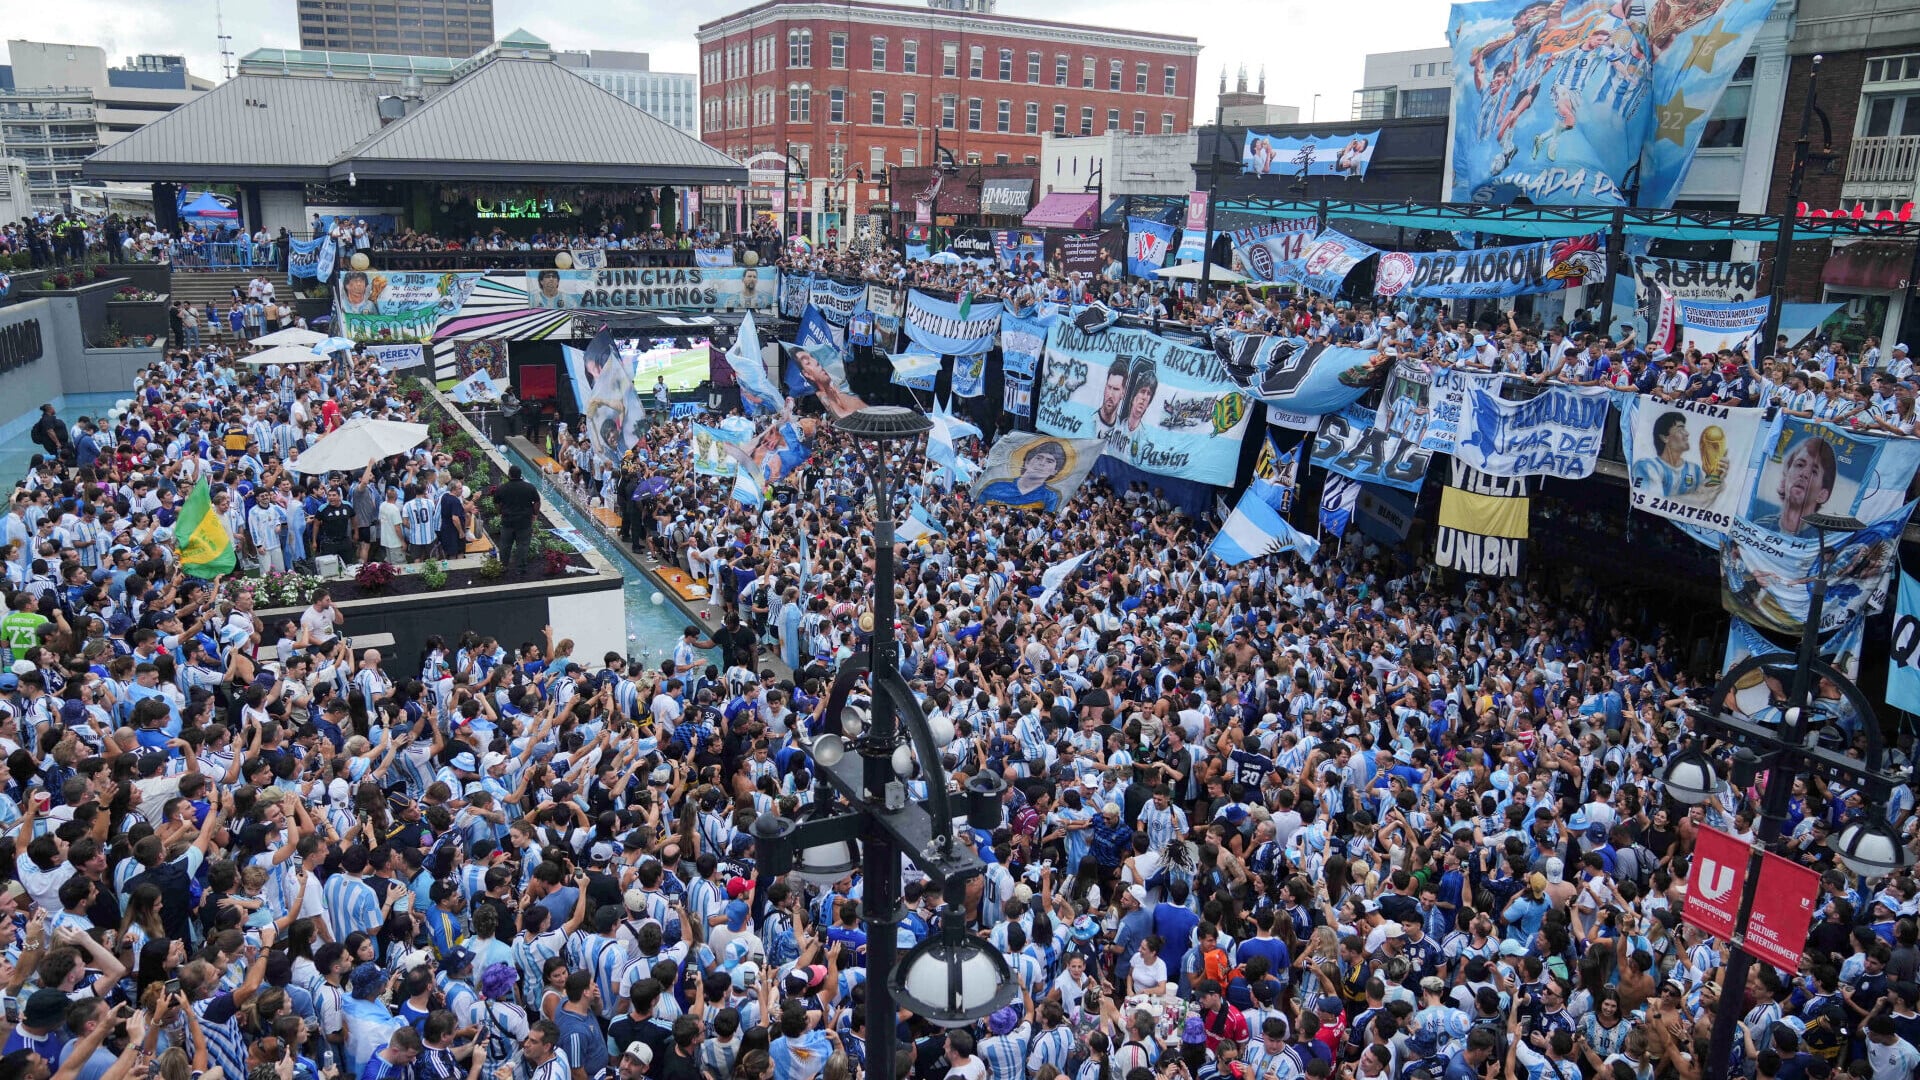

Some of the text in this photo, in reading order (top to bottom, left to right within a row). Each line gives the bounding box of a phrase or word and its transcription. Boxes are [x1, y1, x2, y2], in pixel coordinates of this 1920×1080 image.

[1661, 110, 1685, 131] 22
[1191, 203, 1203, 219] U
[1234, 215, 1317, 247] LA BARRA
[1280, 233, 1305, 262] 14
[1411, 246, 1546, 289] DEP. MORON
[405, 274, 425, 285] DIOS
[812, 281, 829, 291] LIONEL
[1685, 306, 1700, 316] ESTE
[1732, 307, 1750, 318] AHORA
[1686, 314, 1709, 326] SIEMPRE
[380, 347, 410, 359] PÉREZ
[1510, 391, 1608, 430] ALVARADO
[1675, 400, 1730, 420] BARRA
[1508, 429, 1599, 455] MAR DEL
[1512, 451, 1584, 477] PLATA
[1450, 455, 1527, 496] VILLA
[413, 507, 429, 525] 10
[1649, 498, 1731, 528] ZAPATEROS
[1765, 535, 1783, 546] EN
[1434, 526, 1519, 577] UNION
[6, 625, 37, 649] 23
[730, 678, 744, 697] 10
[1240, 769, 1260, 786] 20
[724, 862, 744, 877] MESS
[1697, 857, 1736, 904] U
[1688, 895, 1732, 922] UNDERGROUND
[1749, 921, 1780, 942] CULTURE.
[1746, 931, 1800, 963] ENTERTAINMENT.
[1599, 1036, 1610, 1049] 10
